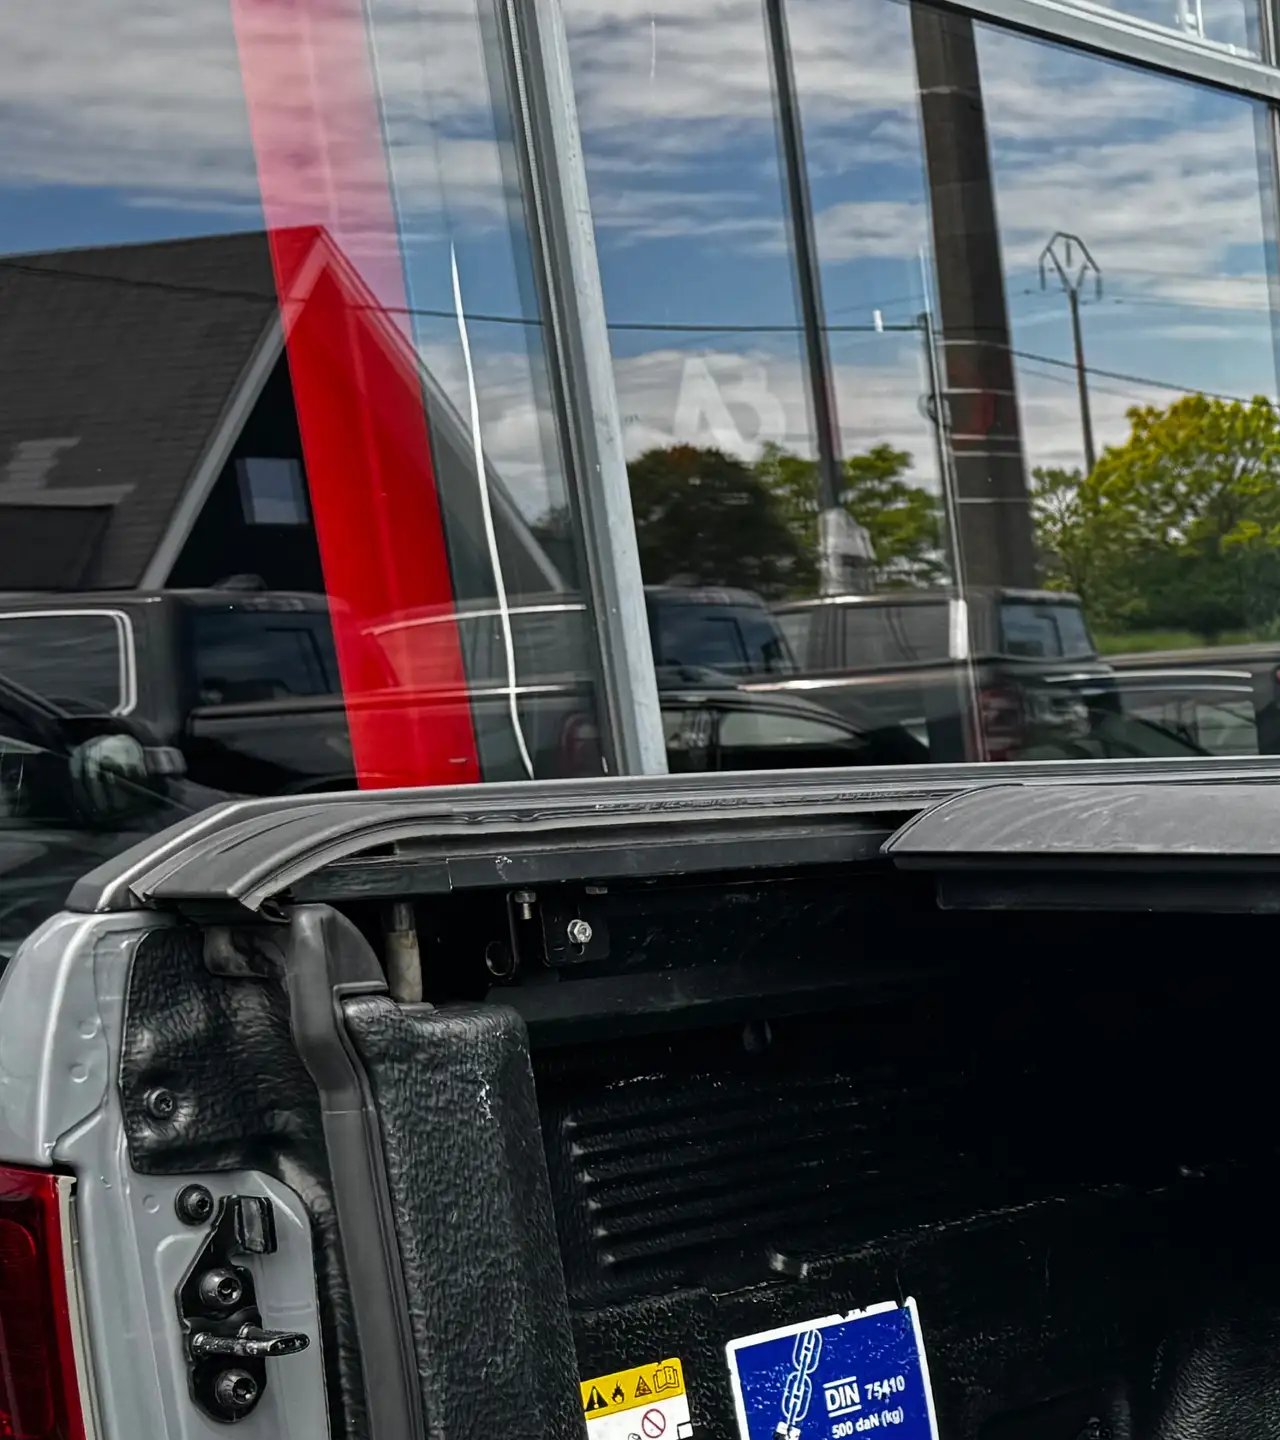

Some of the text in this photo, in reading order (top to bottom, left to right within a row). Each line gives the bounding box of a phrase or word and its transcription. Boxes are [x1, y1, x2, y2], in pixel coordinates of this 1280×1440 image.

[824, 1375, 905, 1411] DIN 75410
[832, 1405, 904, 1439] 500 daN (kg)
